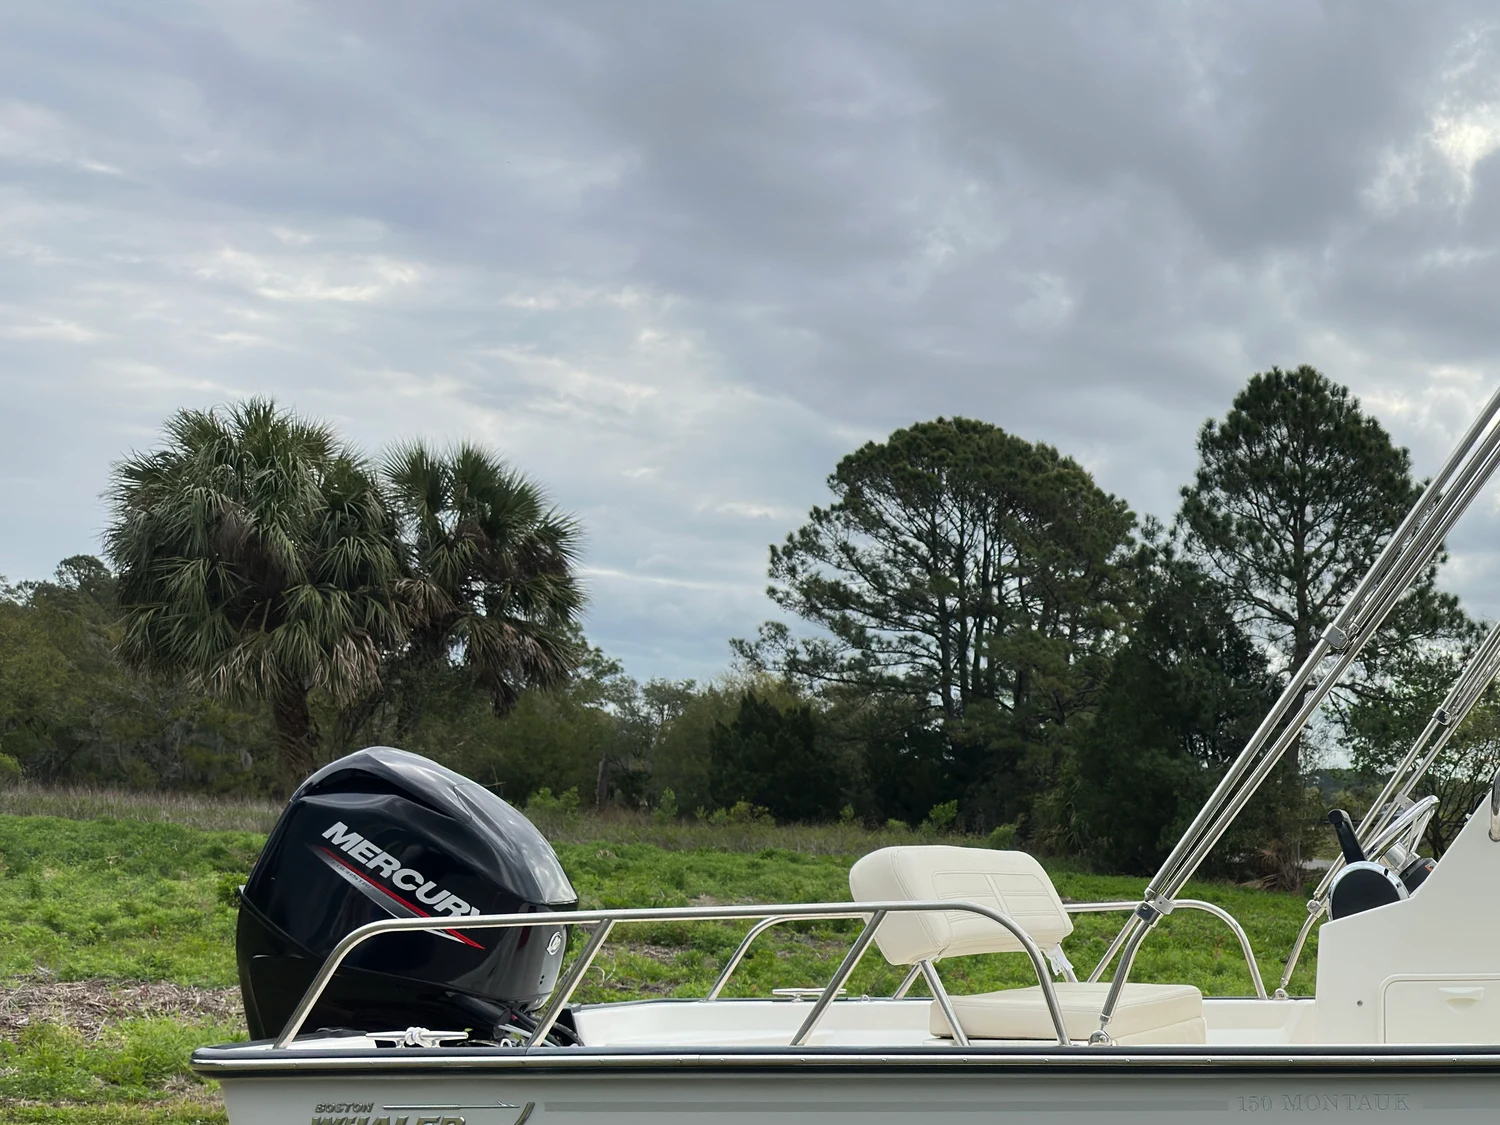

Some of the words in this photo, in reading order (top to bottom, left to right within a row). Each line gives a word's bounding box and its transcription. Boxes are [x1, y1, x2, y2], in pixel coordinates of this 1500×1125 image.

[315, 1102, 375, 1114] BOSTON
[1237, 1096, 1273, 1112] 150
[1282, 1093, 1411, 1112] MONTAUK
